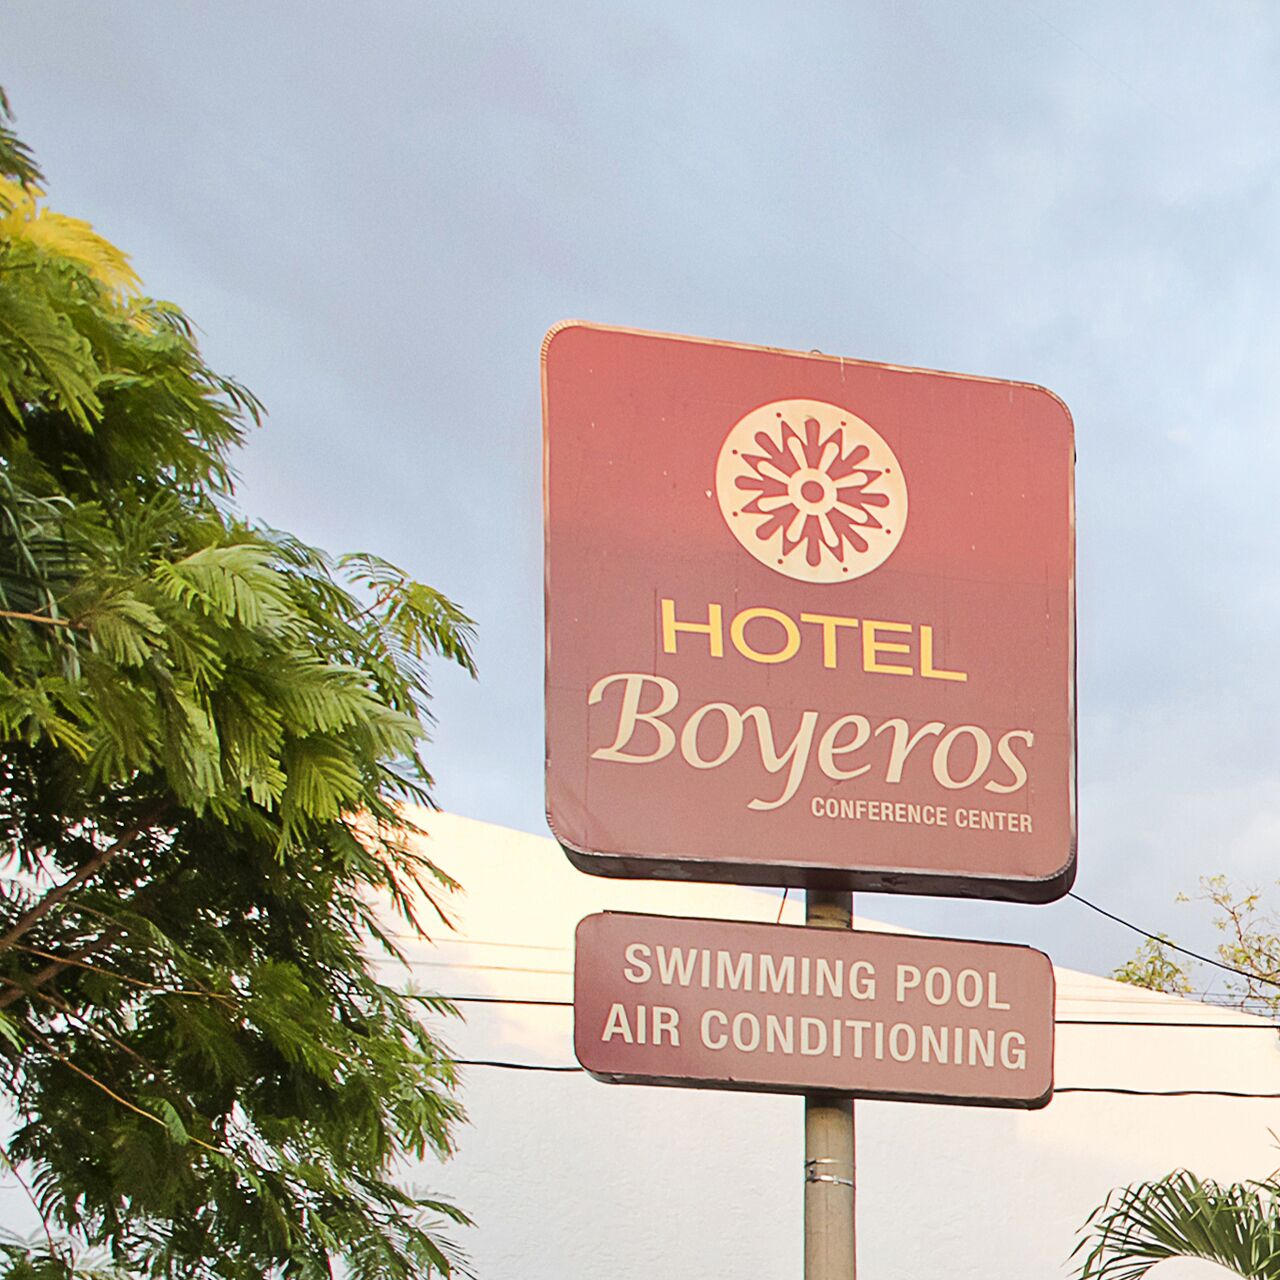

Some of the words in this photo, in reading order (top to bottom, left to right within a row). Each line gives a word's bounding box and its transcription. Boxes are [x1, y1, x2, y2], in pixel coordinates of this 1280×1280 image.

[660, 598, 968, 682] HOTEL
[587, 672, 1034, 810] Boyeros
[811, 797, 948, 826] CONFERENCE
[955, 808, 1033, 833] CENTER
[623, 943, 876, 1000] SWIMMING
[896, 964, 1010, 1010] POOL
[601, 1003, 681, 1047] AIR
[700, 1009, 1027, 1070] CONDITIONING
